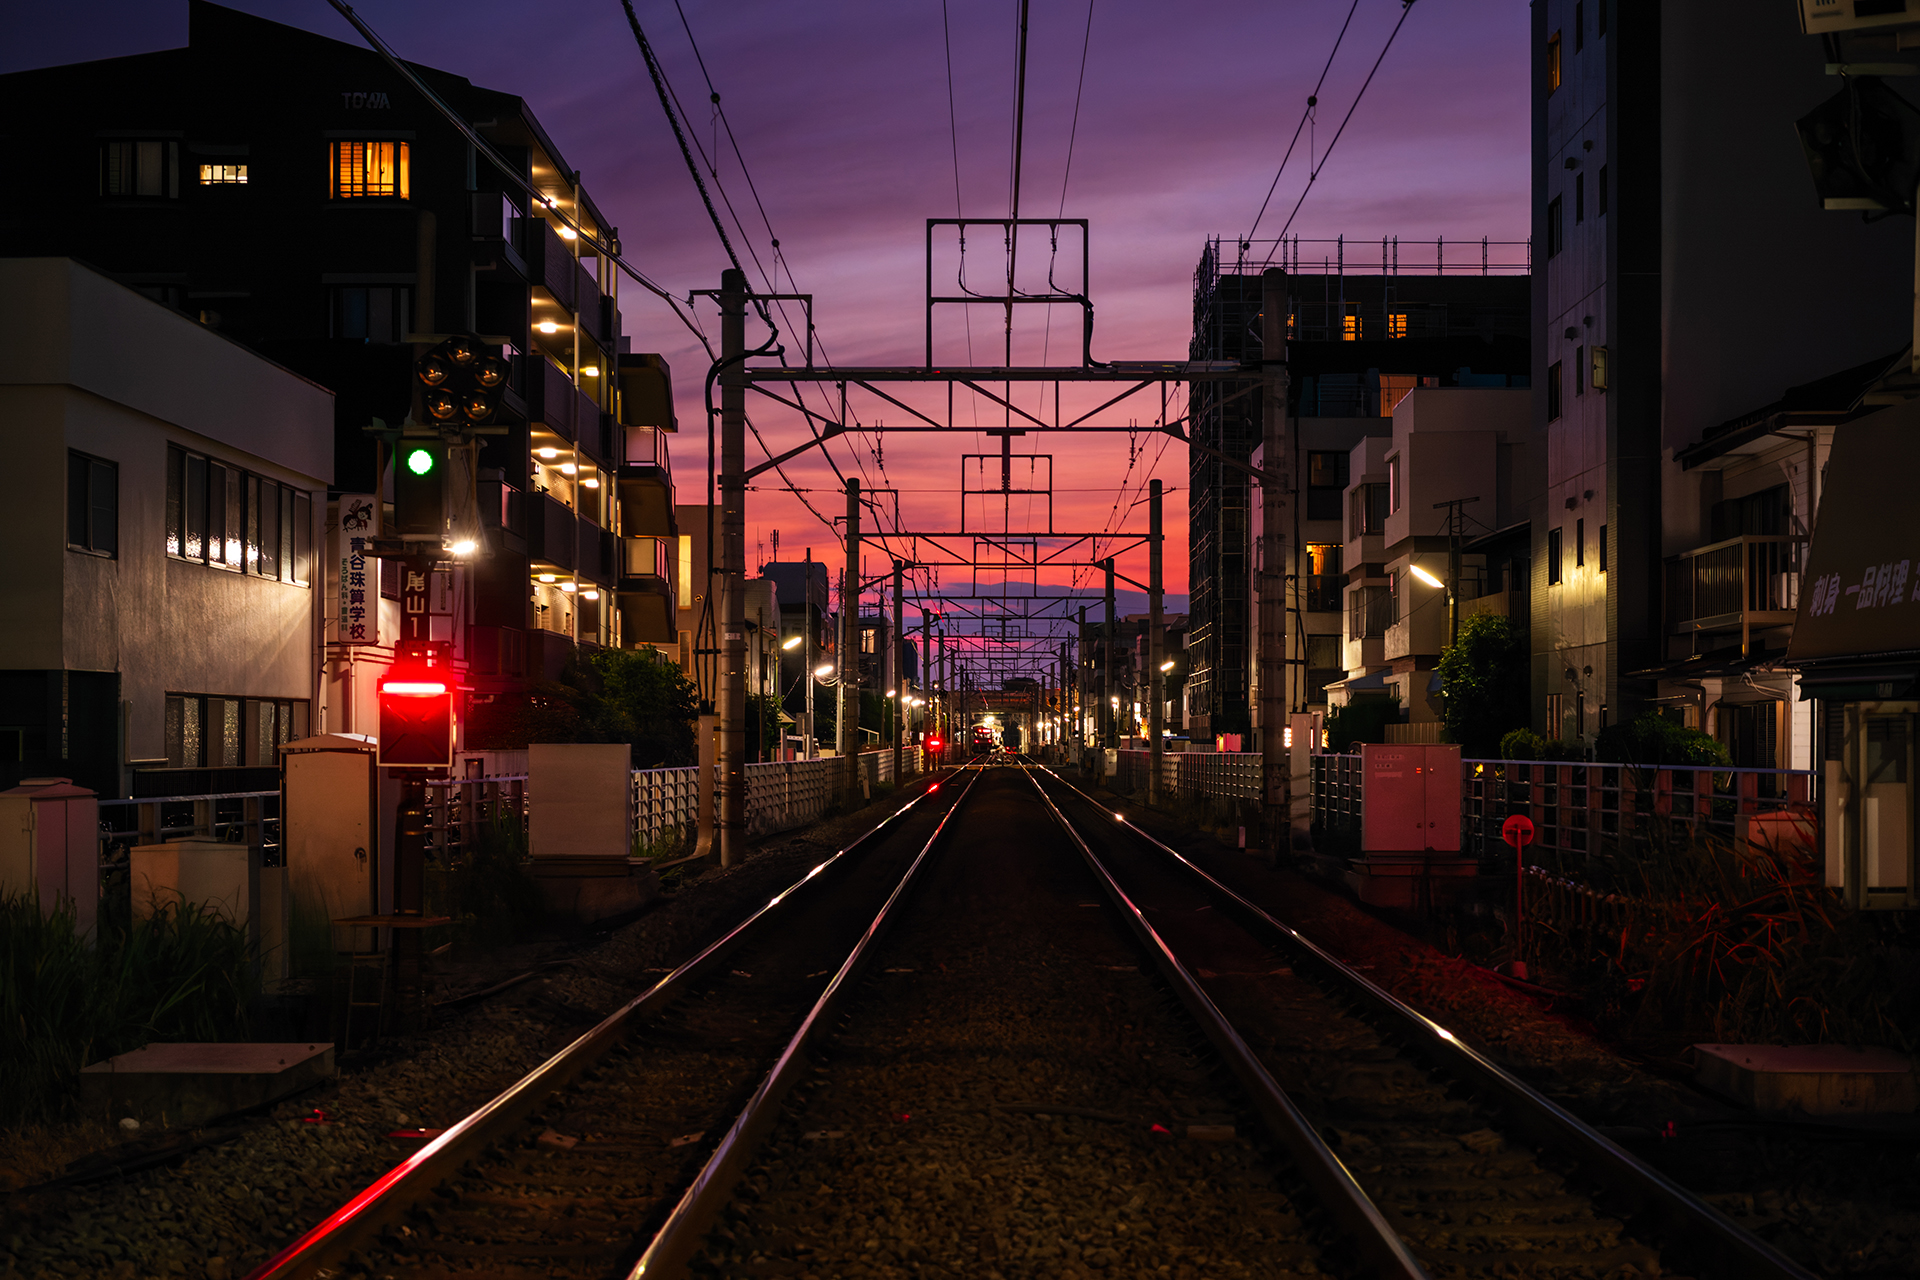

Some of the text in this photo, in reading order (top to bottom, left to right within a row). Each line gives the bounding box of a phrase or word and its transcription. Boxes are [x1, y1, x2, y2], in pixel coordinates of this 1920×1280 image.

[341, 91, 391, 110] TOWA
[405, 570, 425, 638] 尾山1
[1809, 571, 1841, 617] 刺身
[1845, 559, 1910, 611] 一品料理
